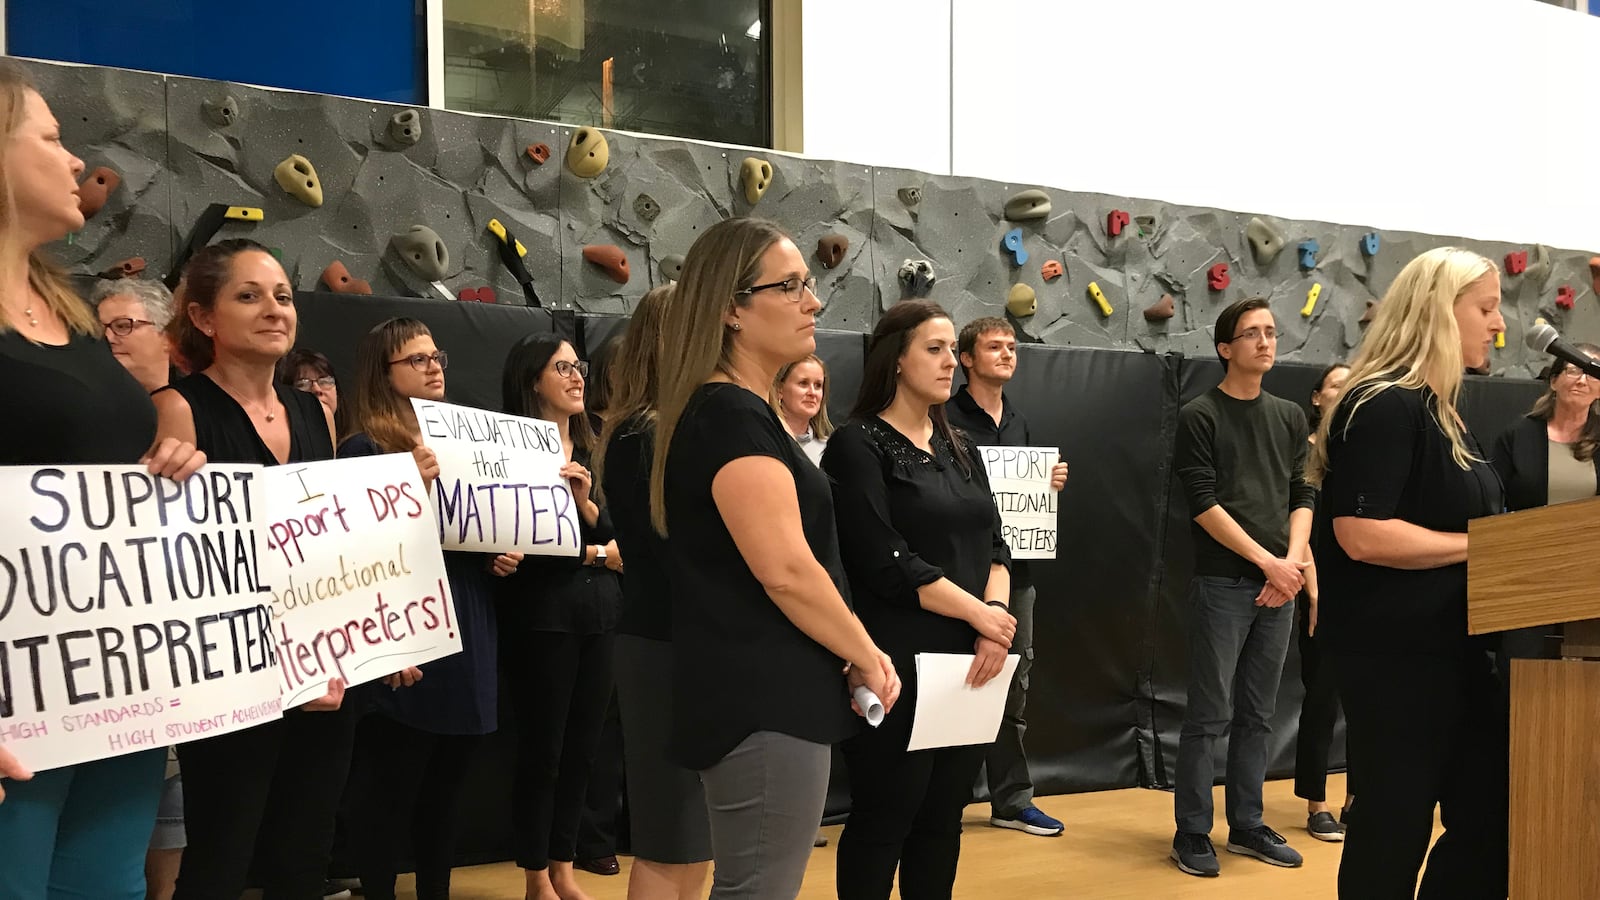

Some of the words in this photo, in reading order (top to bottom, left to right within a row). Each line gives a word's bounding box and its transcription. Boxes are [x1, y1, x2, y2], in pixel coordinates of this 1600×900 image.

[422, 404, 561, 454] EVALUATIONS
[286, 467, 325, 504] I
[472, 450, 510, 479] that
[986, 448, 1056, 479] PPORT
[30, 468, 254, 532] SUPPORT
[435, 476, 578, 548] MATTER
[267, 493, 351, 568] pport
[366, 481, 423, 522] DPS
[1002, 525, 1057, 552] PRETERS
[271, 542, 412, 619] educational
[0, 718, 49, 742] HIGH
[61, 696, 165, 732] STANDARDS
[107, 727, 157, 752] HIGH
[165, 713, 228, 739] STUDENT
